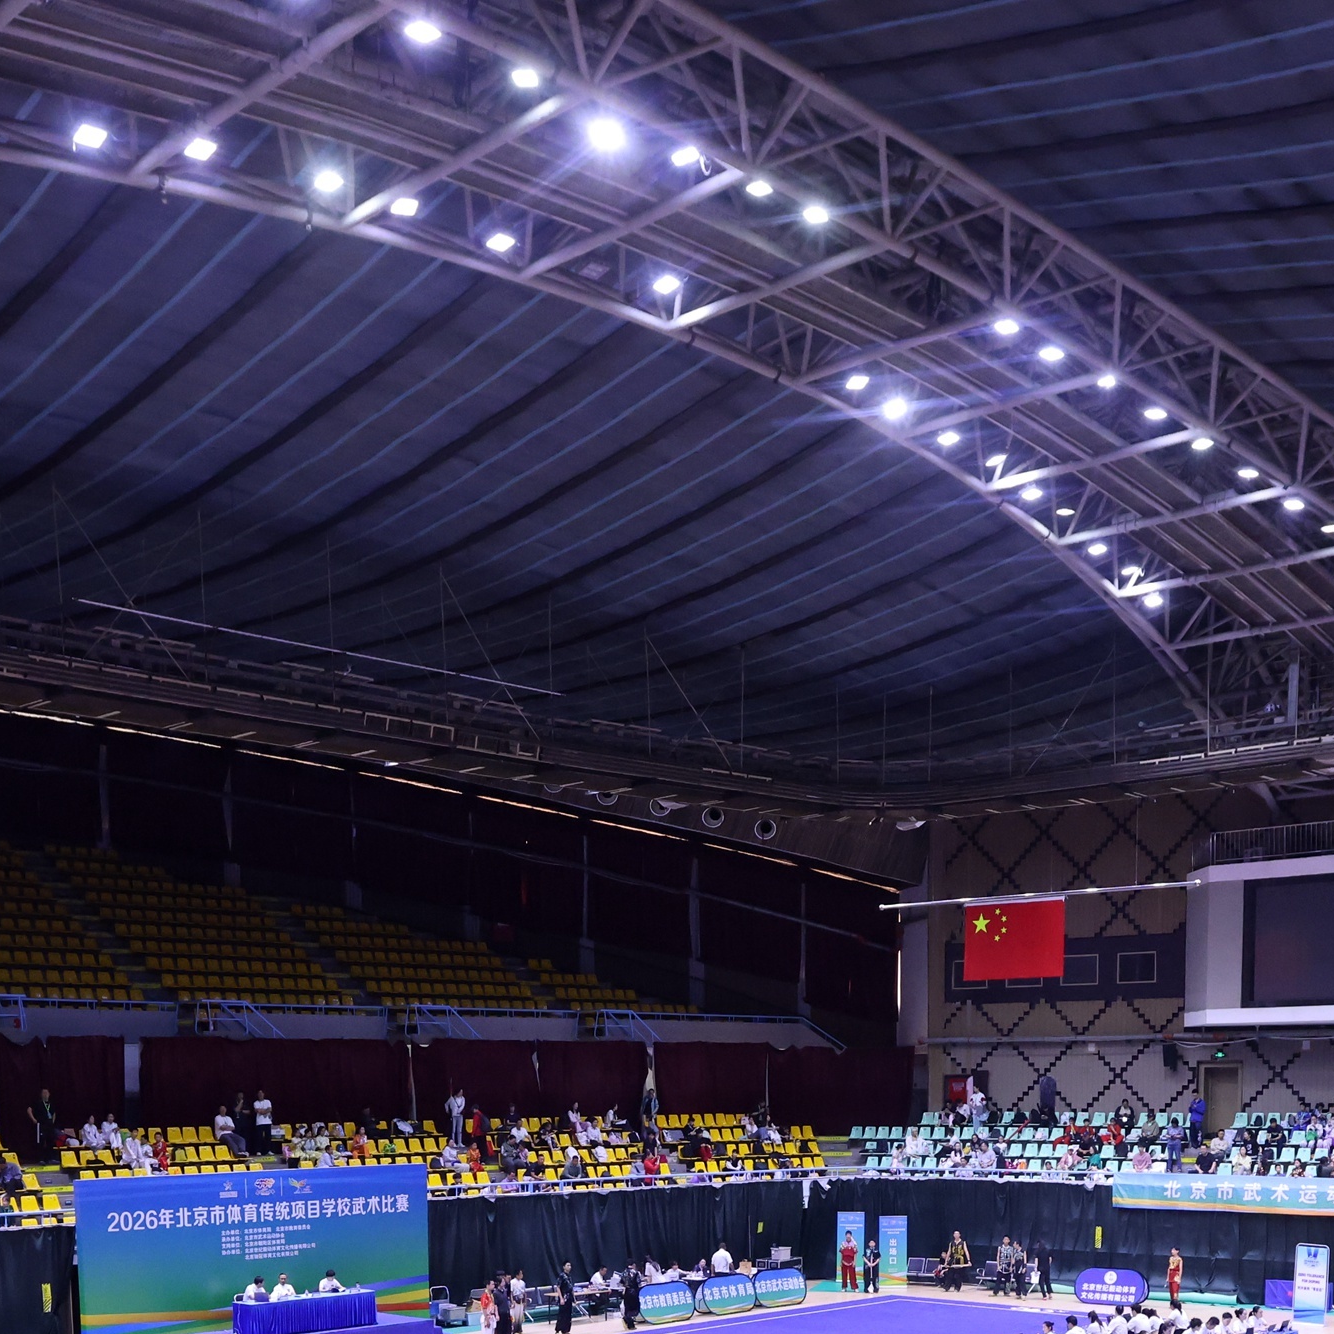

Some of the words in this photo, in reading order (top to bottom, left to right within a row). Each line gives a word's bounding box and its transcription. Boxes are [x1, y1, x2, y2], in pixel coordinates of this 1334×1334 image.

[107, 1193, 409, 1233] 2026年北京市体育传统项目学校武术比赛
[704, 1282, 754, 1300] 北京市体育局
[755, 1276, 805, 1293] 北京市武术运动协会
[639, 1290, 693, 1309] 北京市教育委员会
[1081, 1292, 1135, 1303] 文化传播有限公司
